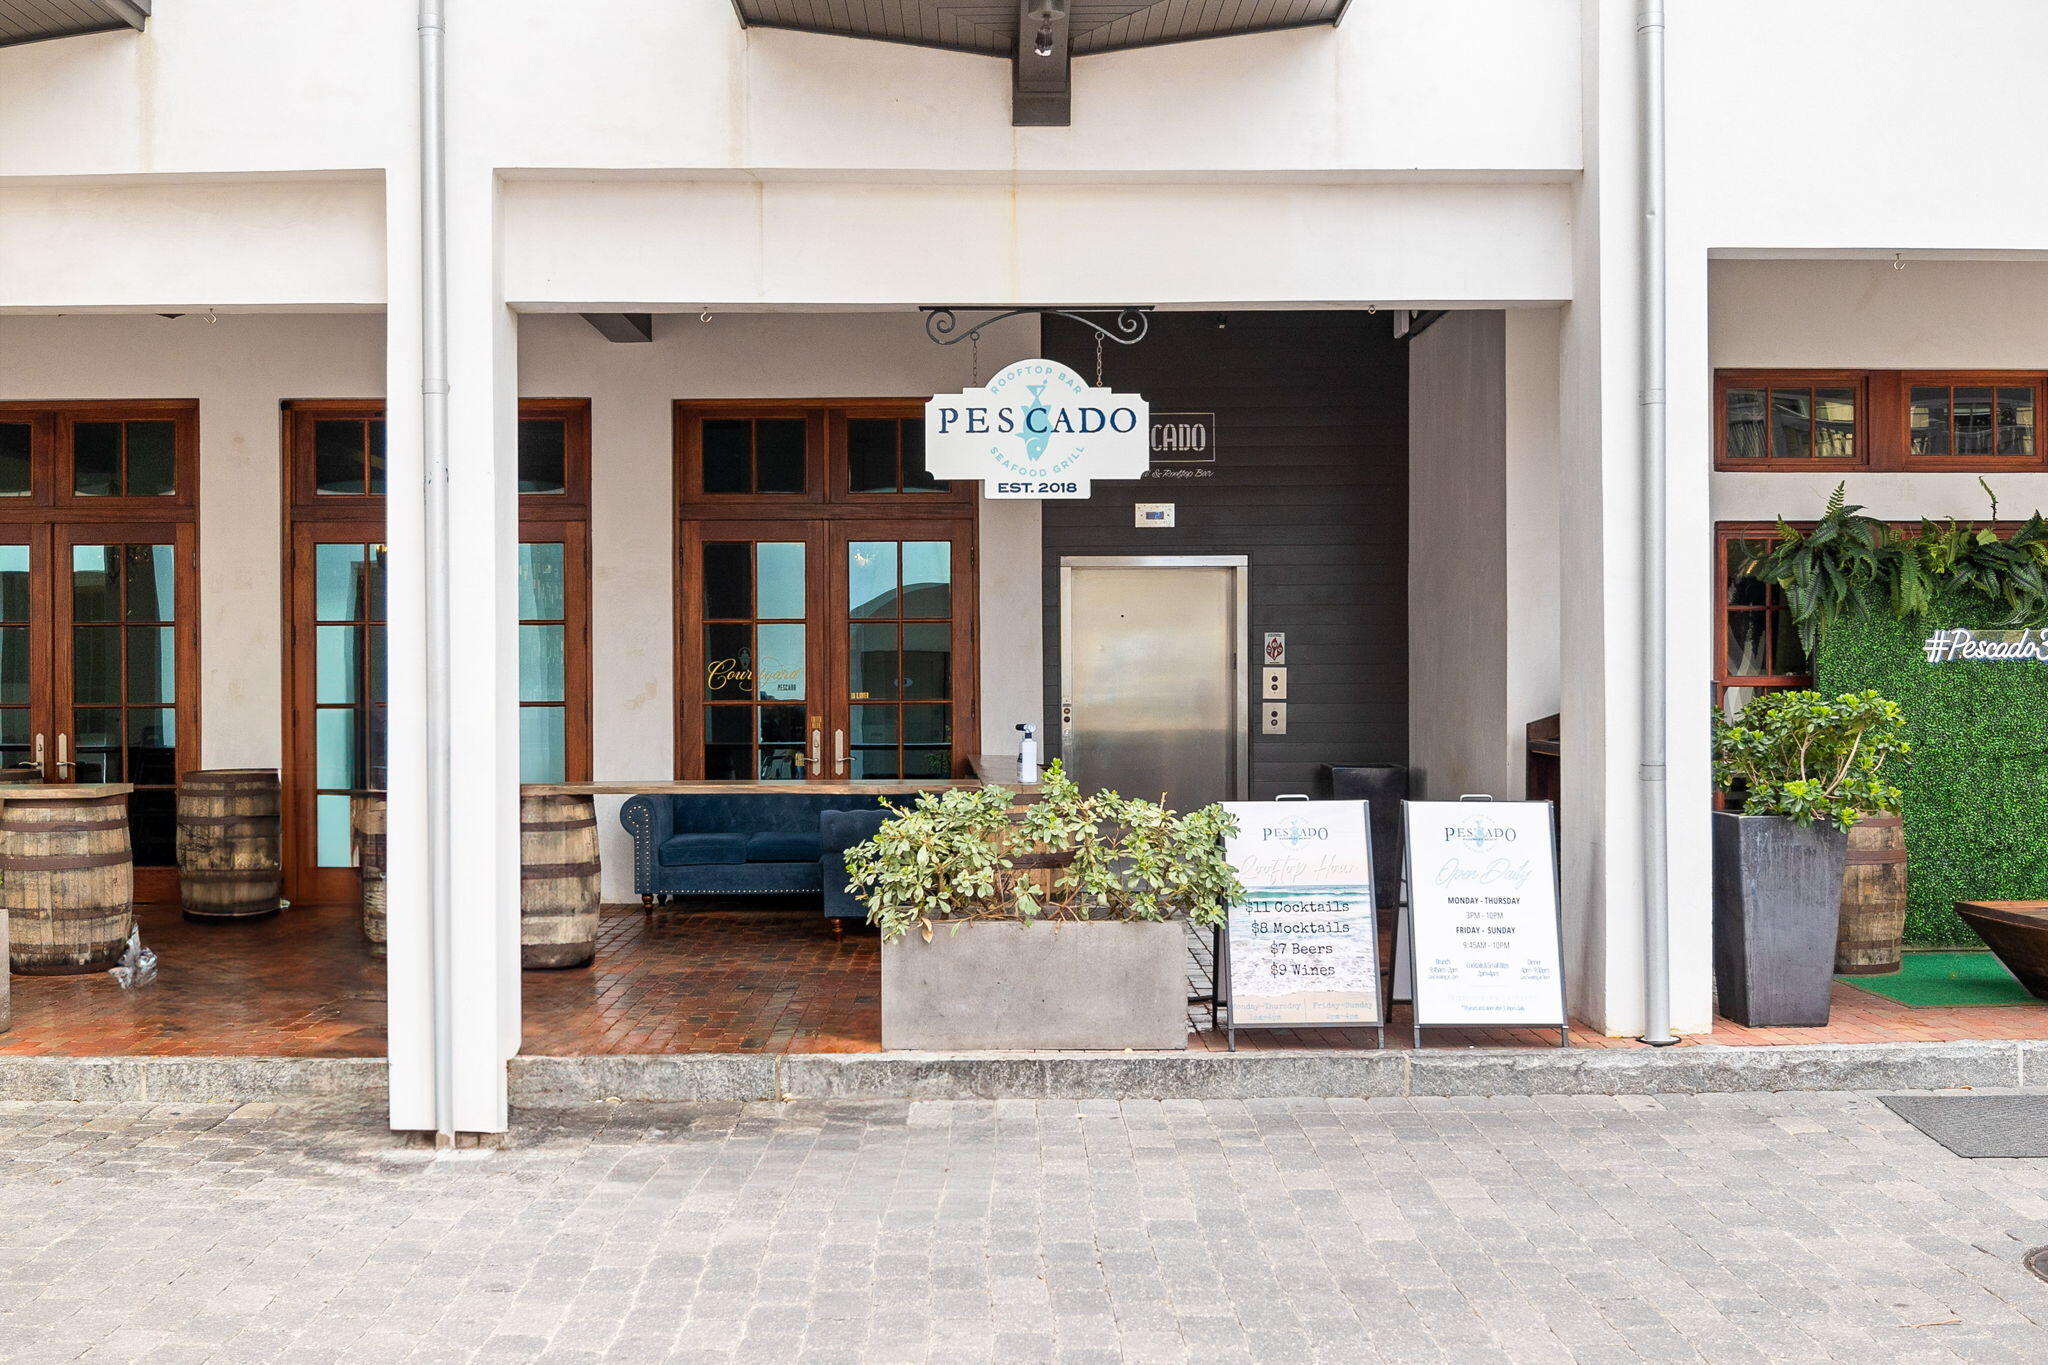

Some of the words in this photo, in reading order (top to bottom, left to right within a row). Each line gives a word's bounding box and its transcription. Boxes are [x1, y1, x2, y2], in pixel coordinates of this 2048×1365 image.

[990, 366, 1053, 395] ROOFTOP
[1058, 372, 1082, 394] BAR
[938, 407, 1137, 434] PESCADO
[1150, 424, 1206, 452] CADO
[990, 446, 1047, 477] SEAFOOD
[1052, 447, 1085, 473] GRILL
[998, 482, 1034, 493] EST.
[1038, 482, 1077, 493] 2018
[1262, 826, 1329, 841] PESADO
[1445, 827, 1516, 842] PESADO
[1436, 857, 1479, 888] Open
[1479, 857, 1531, 888] Daily
[1245, 901, 1270, 915] $11
[1274, 901, 1350, 914] Cocktails
[1251, 921, 1269, 935] $8
[1273, 921, 1350, 934] Mocktails
[1270, 942, 1287, 957] $7
[1292, 943, 1333, 955] Beers
[1270, 963, 1288, 979] $9
[1292, 964, 1336, 976] Wines
